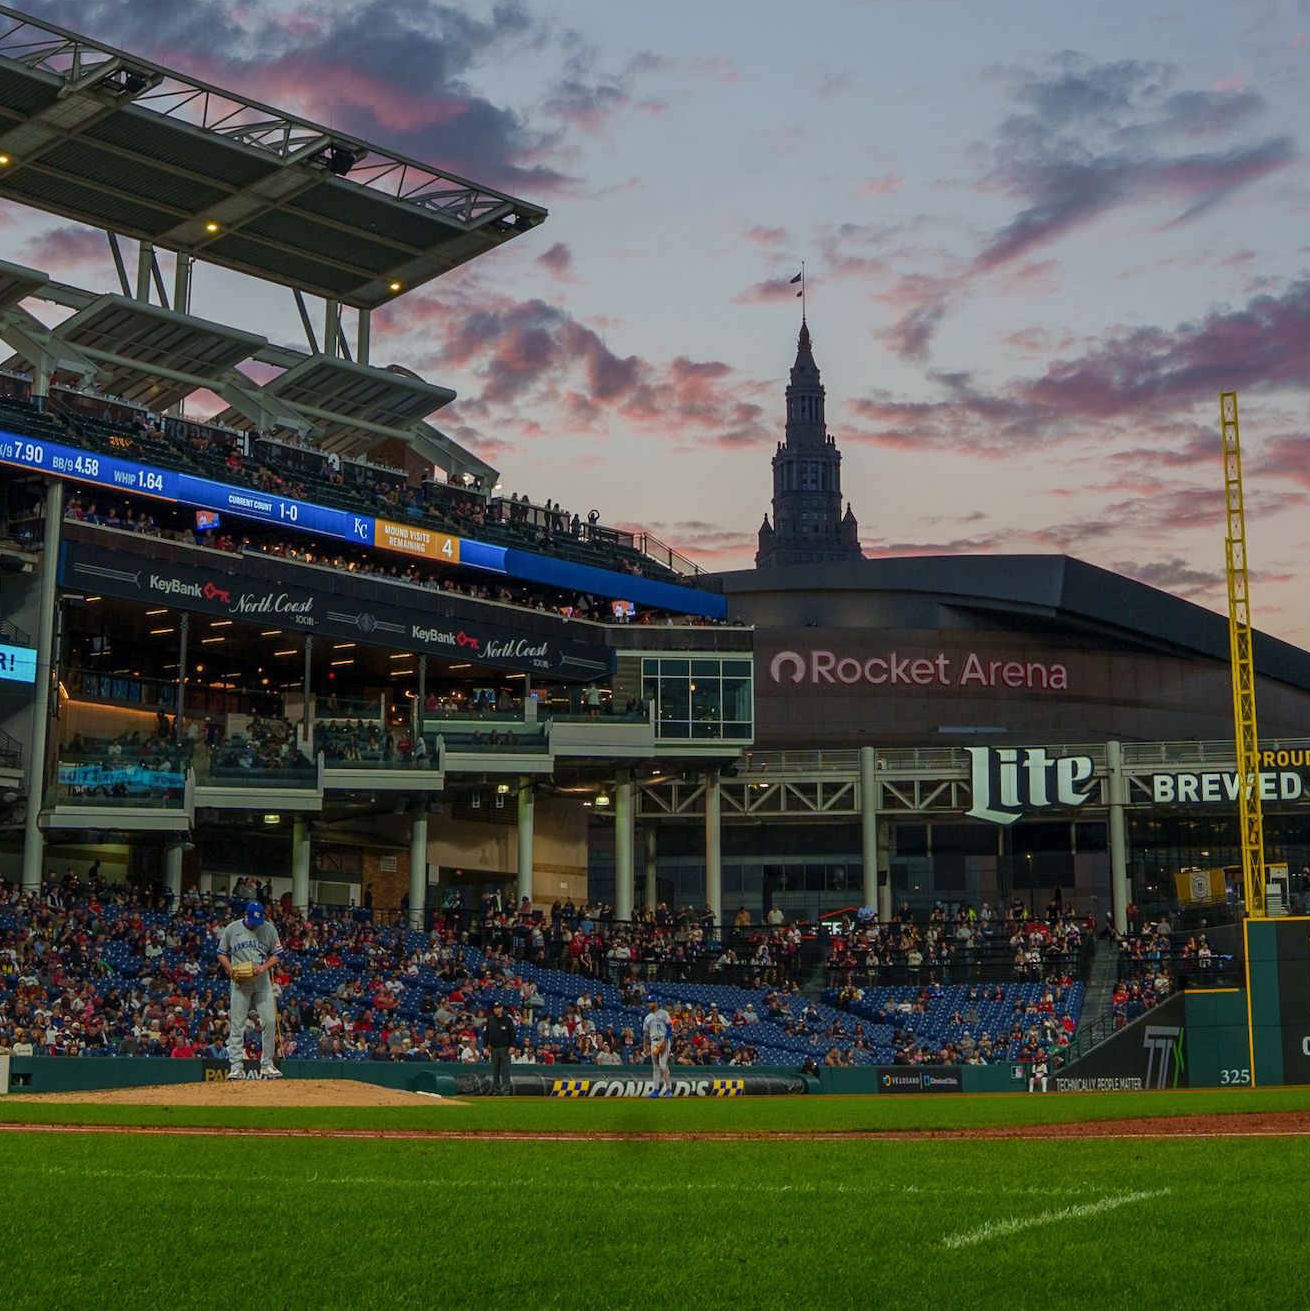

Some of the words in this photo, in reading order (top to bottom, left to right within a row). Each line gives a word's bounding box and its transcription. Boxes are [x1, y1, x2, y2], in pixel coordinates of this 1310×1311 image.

[354, 517, 368, 539] KC
[384, 525, 409, 540] MOUND
[410, 529, 430, 544] VISITS
[389, 538, 425, 553] REMAINING
[442, 539, 453, 557] 4
[149, 574, 202, 598] KeyBank
[229, 593, 274, 613] North
[273, 592, 314, 613] Coast
[295, 615, 315, 626] SOCIAL
[412, 625, 456, 646] KeyBank
[478, 640, 515, 658] North
[515, 639, 548, 657] Coast
[812, 650, 950, 686] Rocket
[959, 652, 1068, 690] Arena
[963, 746, 1093, 825] Lite
[1153, 771, 1302, 803] BREWED
[892, 1076, 919, 1085] VELOSANO
[1056, 1078, 1097, 1091] TECHNICALLY
[1098, 1078, 1119, 1091] PEOPLE
[1120, 1078, 1143, 1090] MATTER
[1220, 1069, 1251, 1084] 325
